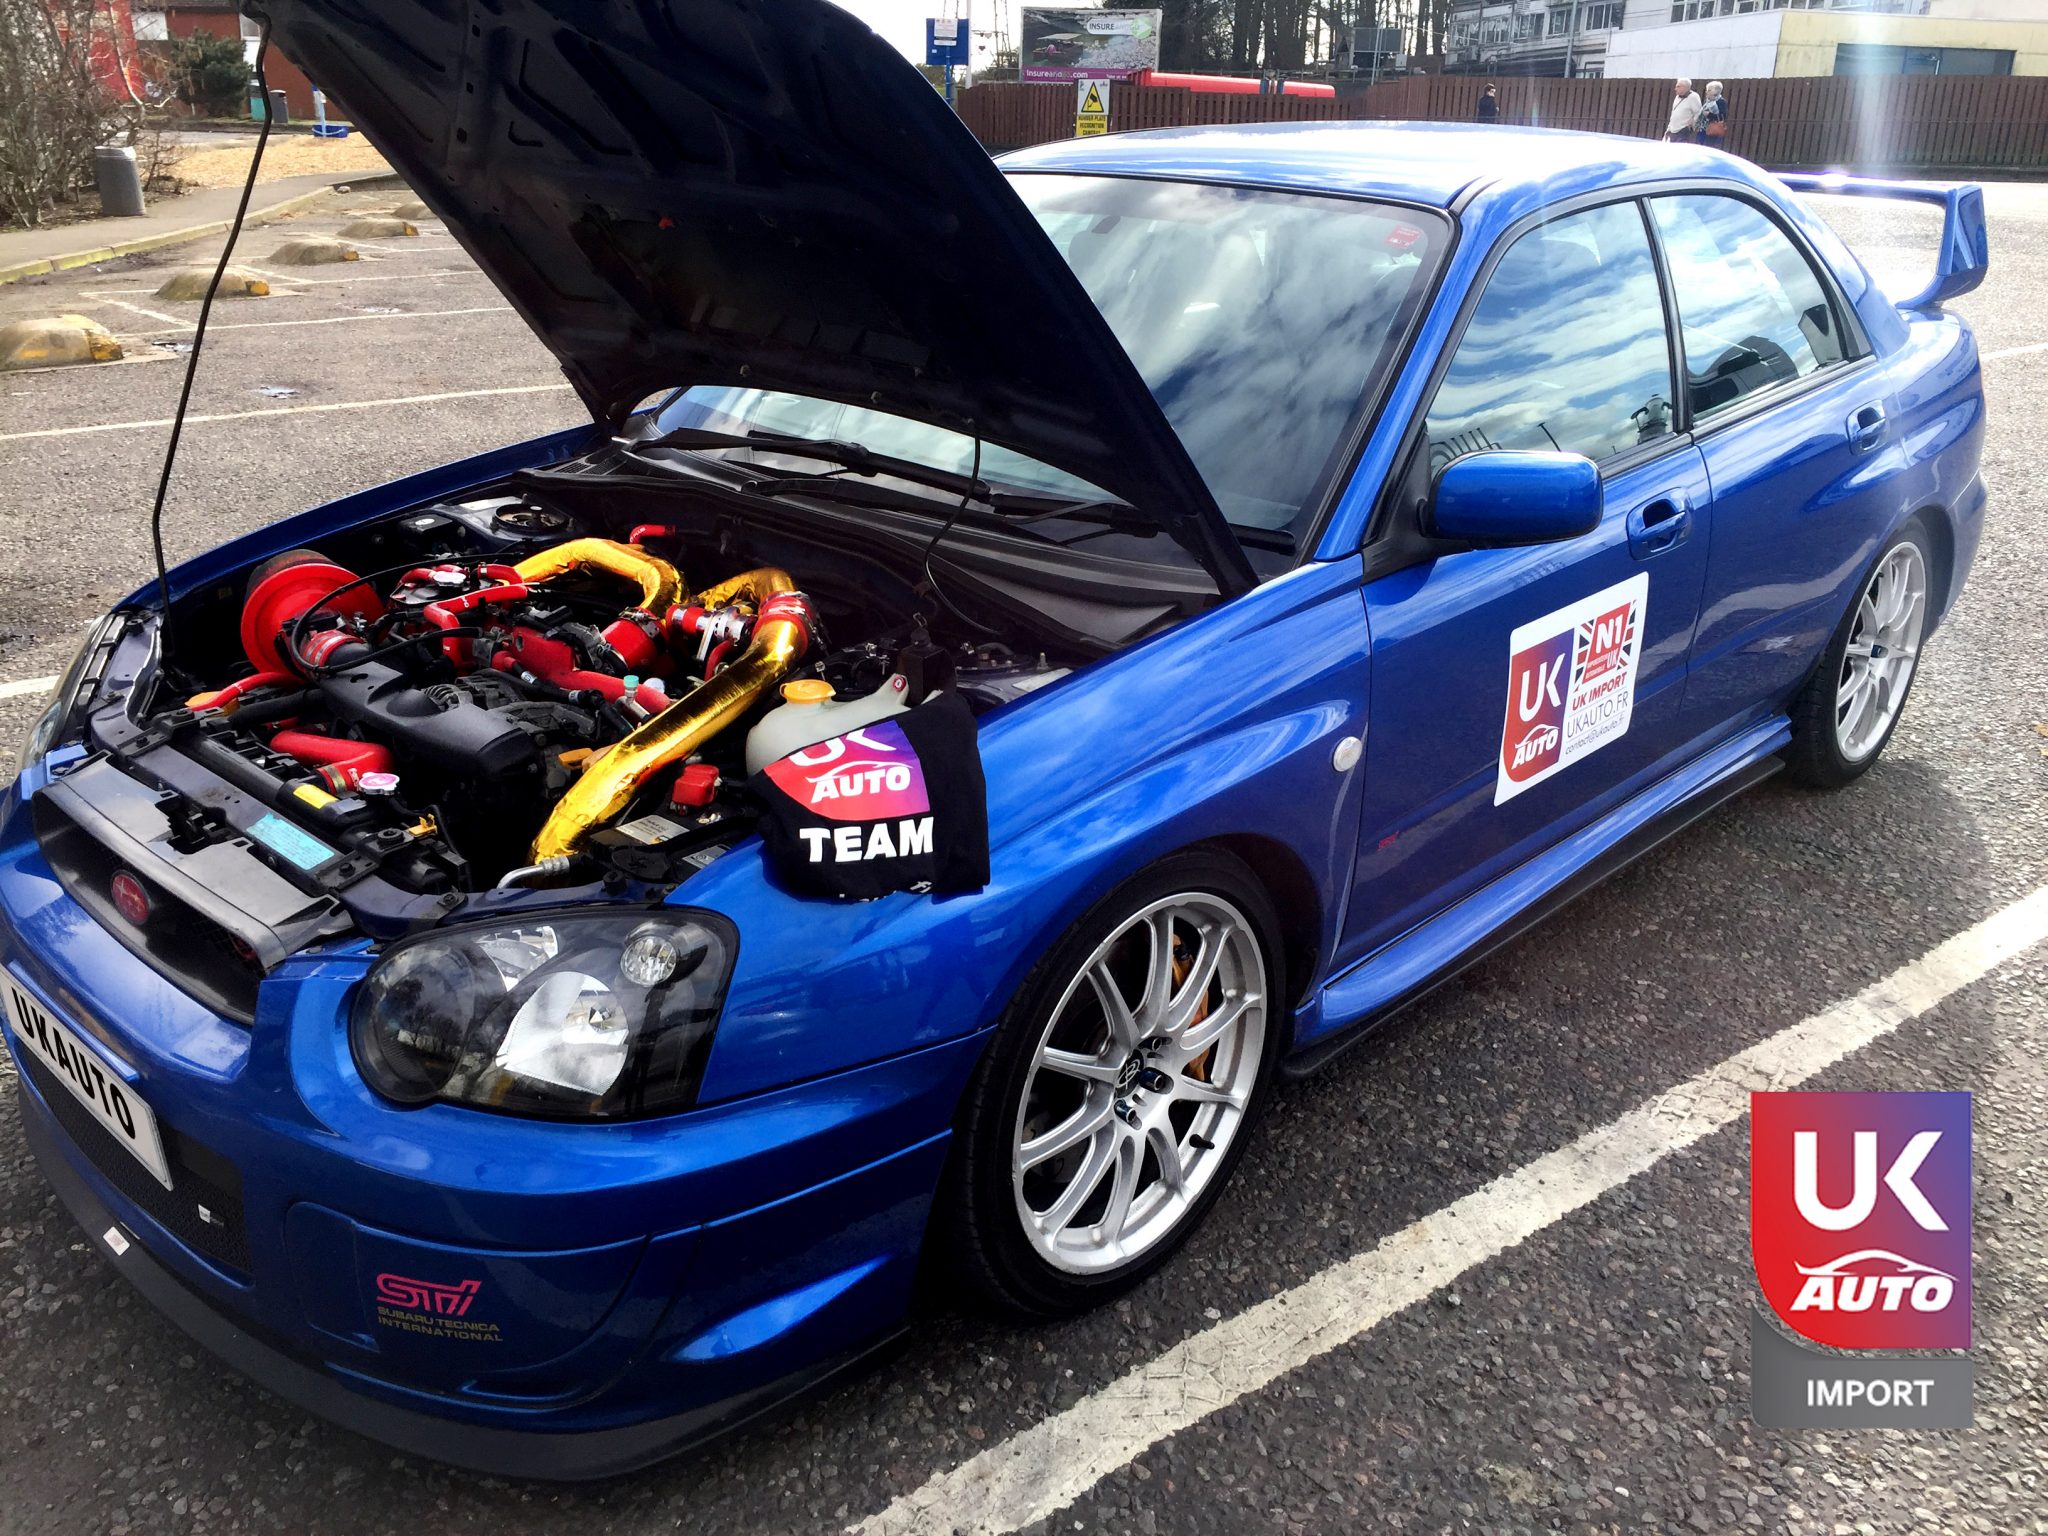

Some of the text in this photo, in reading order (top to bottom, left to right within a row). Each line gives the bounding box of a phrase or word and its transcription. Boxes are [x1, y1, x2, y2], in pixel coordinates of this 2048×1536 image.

[1595, 614, 1623, 653] N1
[1519, 653, 1566, 723] UK
[1572, 672, 1627, 711] UK IMPORT
[1567, 691, 1629, 738] UKAUTO.FR
[1511, 728, 1559, 770] AUTO
[811, 767, 911, 803] AUTO
[799, 816, 935, 863] TEAM
[11, 987, 136, 1140] UKAUTO
[377, 1306, 500, 1332] SUBARU TECNICA
[378, 1316, 503, 1342] INTERNATIONAL
